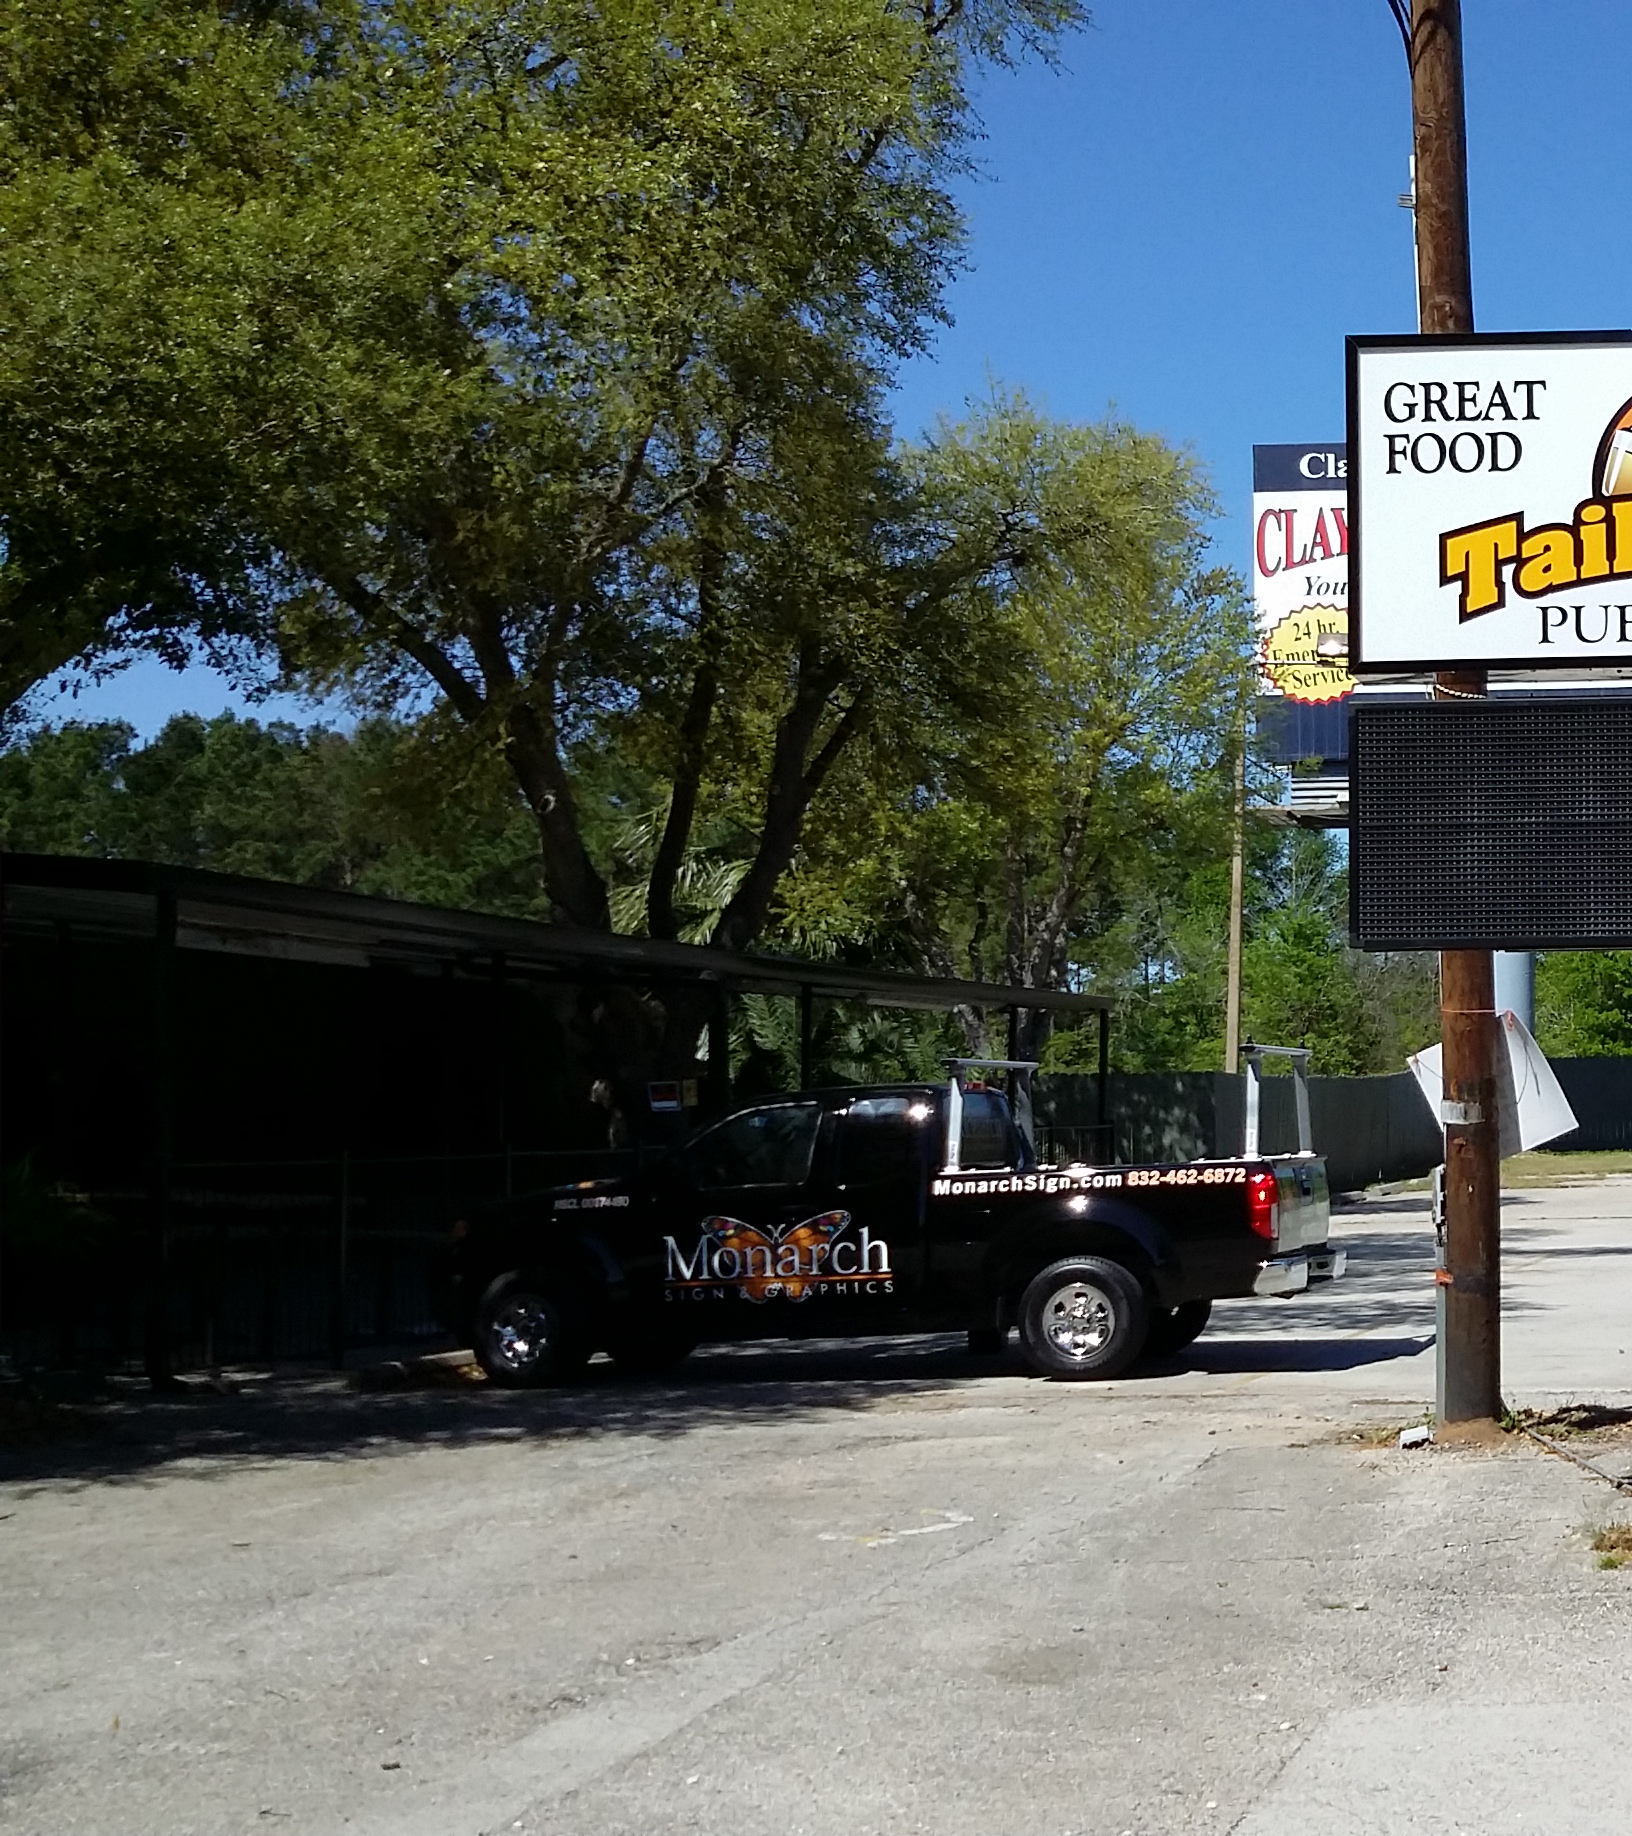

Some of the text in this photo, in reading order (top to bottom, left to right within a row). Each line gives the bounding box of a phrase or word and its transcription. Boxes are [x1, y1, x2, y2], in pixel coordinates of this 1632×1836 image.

[1383, 379, 1546, 424] GREAT
[1383, 431, 1523, 475] FOOD
[1292, 620, 1312, 642] 24
[932, 1167, 1247, 1197] MonarchSign.com 832-462-6872
[662, 1226, 893, 1281] Monarch
[665, 1280, 894, 1302] SIGN & GRAPHICS
